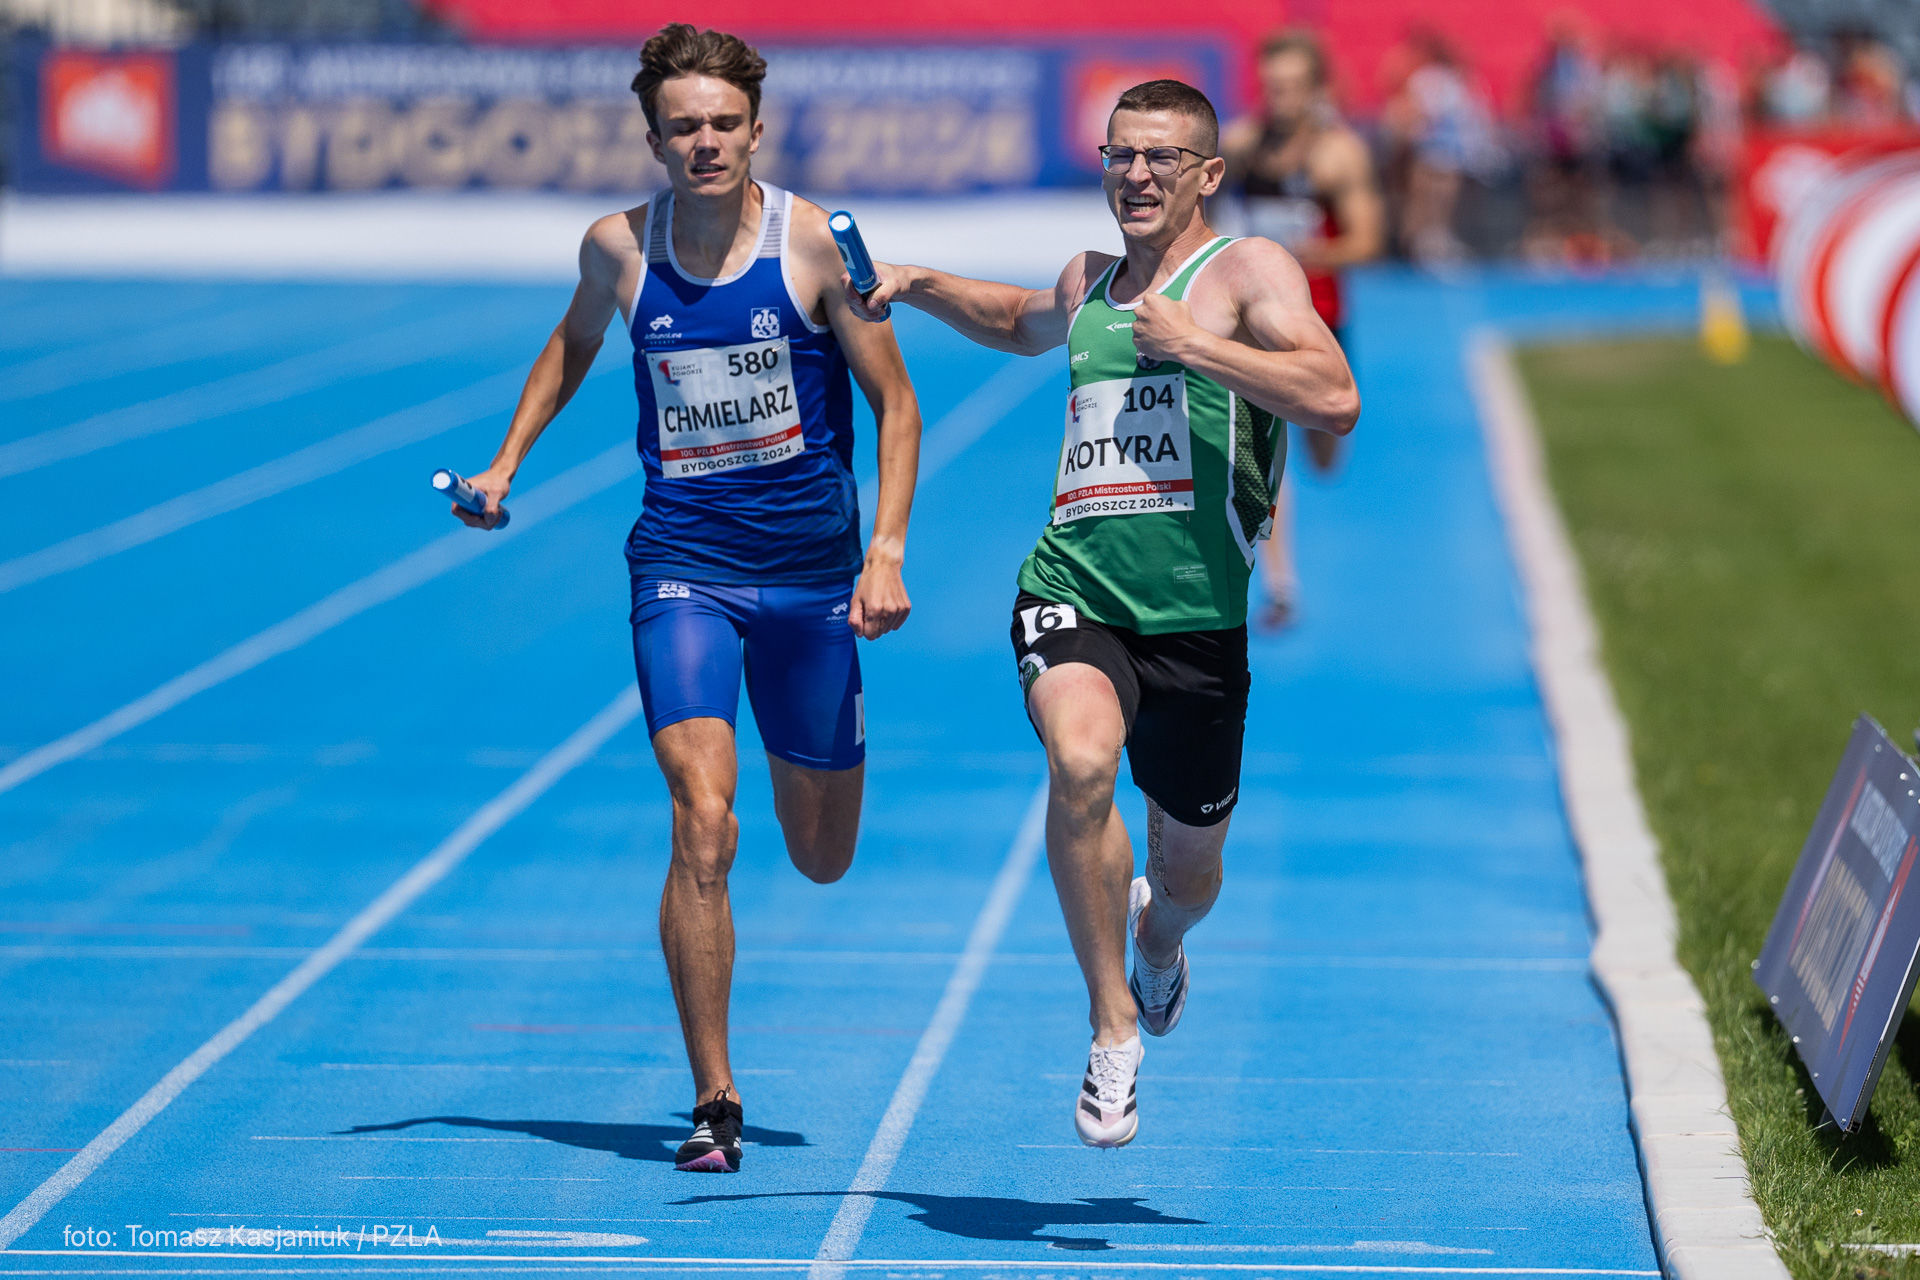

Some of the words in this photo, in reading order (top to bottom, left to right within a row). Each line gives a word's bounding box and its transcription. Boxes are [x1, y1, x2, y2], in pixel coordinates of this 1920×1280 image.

[728, 348, 778, 377] 580
[664, 384, 793, 433] CHMIELARZ
[1123, 384, 1175, 413] 104
[680, 449, 696, 458] 100.
[697, 447, 716, 456] PZLA
[716, 440, 764, 453] Mistrzostwa
[765, 431, 788, 445] Polski
[681, 453, 759, 473] BYDGOSZCZ
[761, 445, 791, 461] 2024
[1065, 433, 1179, 475] KOTYRA
[1078, 488, 1093, 498] PZLA
[1094, 484, 1144, 495] Mistrzostwa
[1145, 481, 1171, 491] Polski
[1066, 500, 1136, 518] BYDGOSZCZ
[1140, 497, 1173, 509] 2024
[1035, 604, 1062, 634] 6
